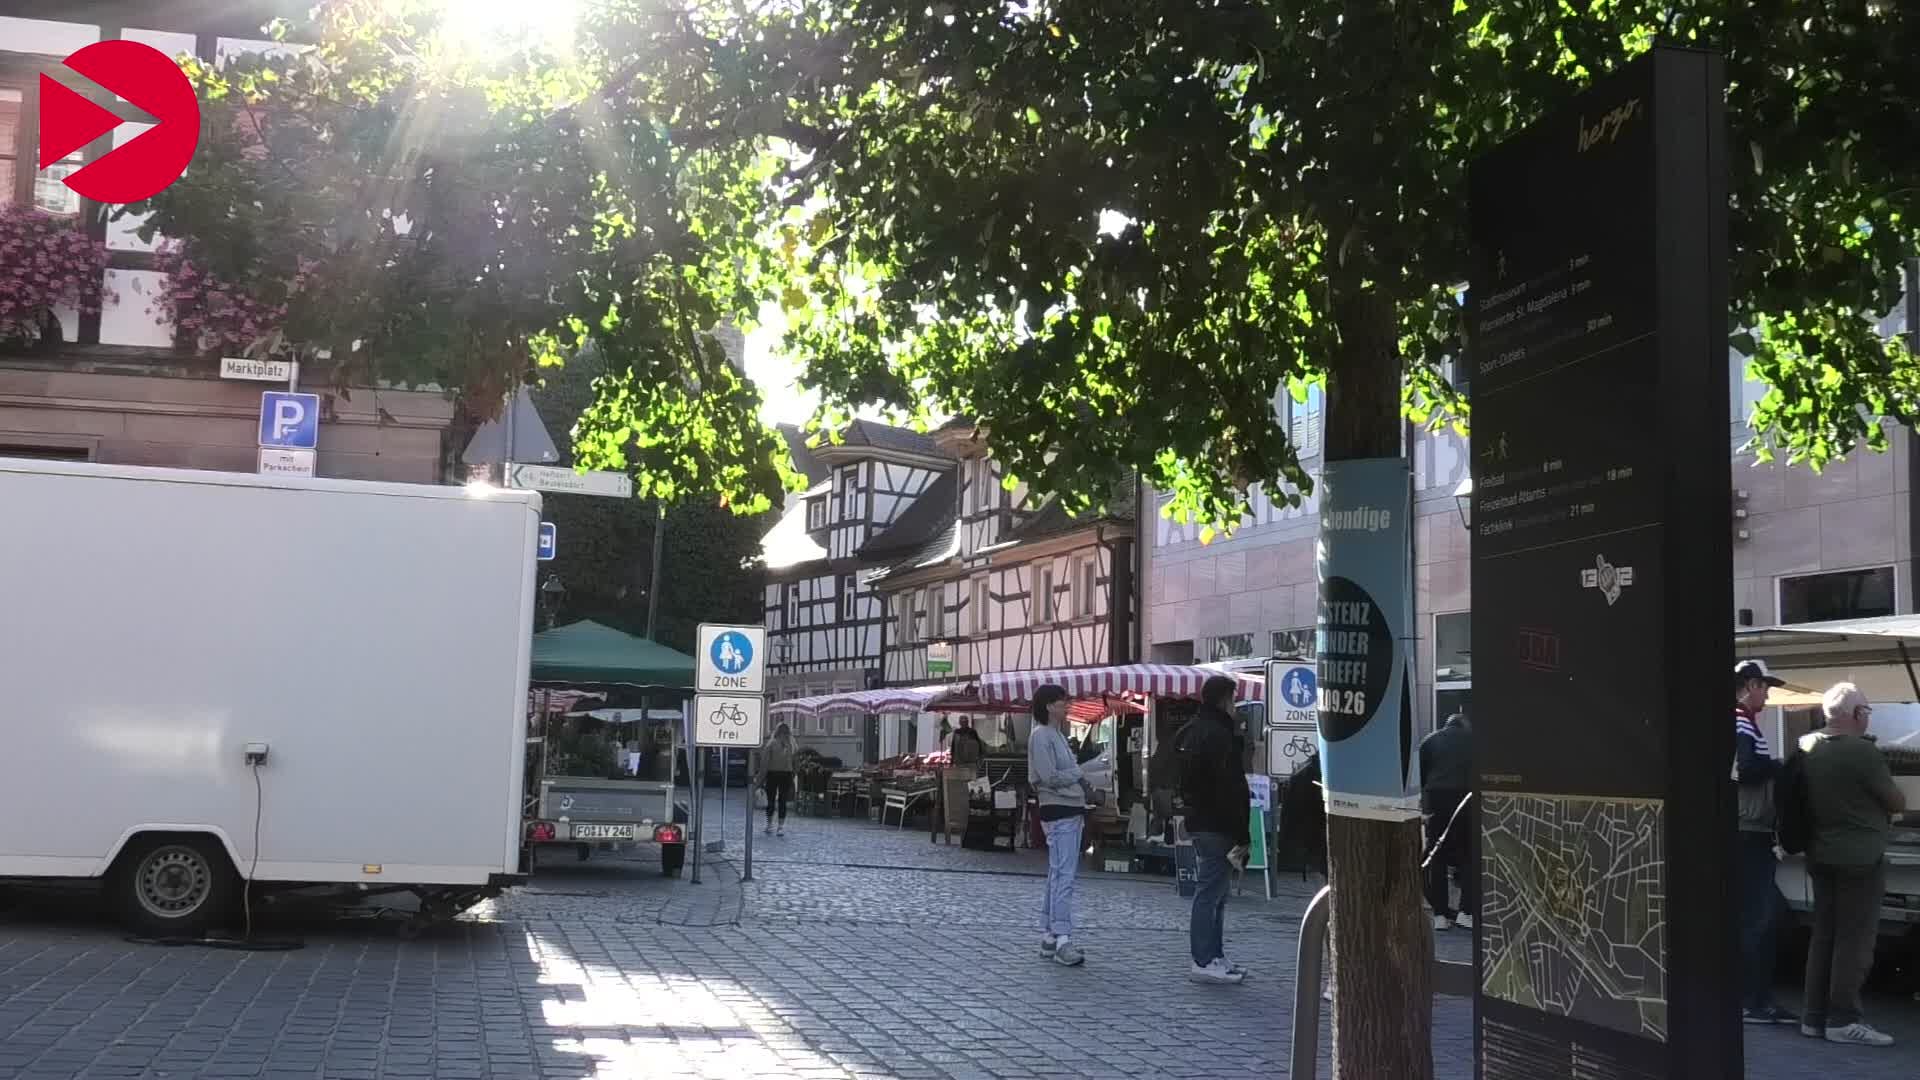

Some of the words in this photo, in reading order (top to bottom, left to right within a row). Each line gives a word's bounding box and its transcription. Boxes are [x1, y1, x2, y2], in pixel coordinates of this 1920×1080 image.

[227, 362, 284, 378] Marktplatz
[272, 399, 304, 440] P
[263, 462, 310, 473] Parkschein
[1326, 506, 1390, 531] bendige
[1325, 601, 1370, 625] STENZ
[714, 675, 748, 688] ZONE
[1285, 710, 1316, 722] ZONE
[718, 728, 738, 740] frei
[612, 825, 632, 837] 248
